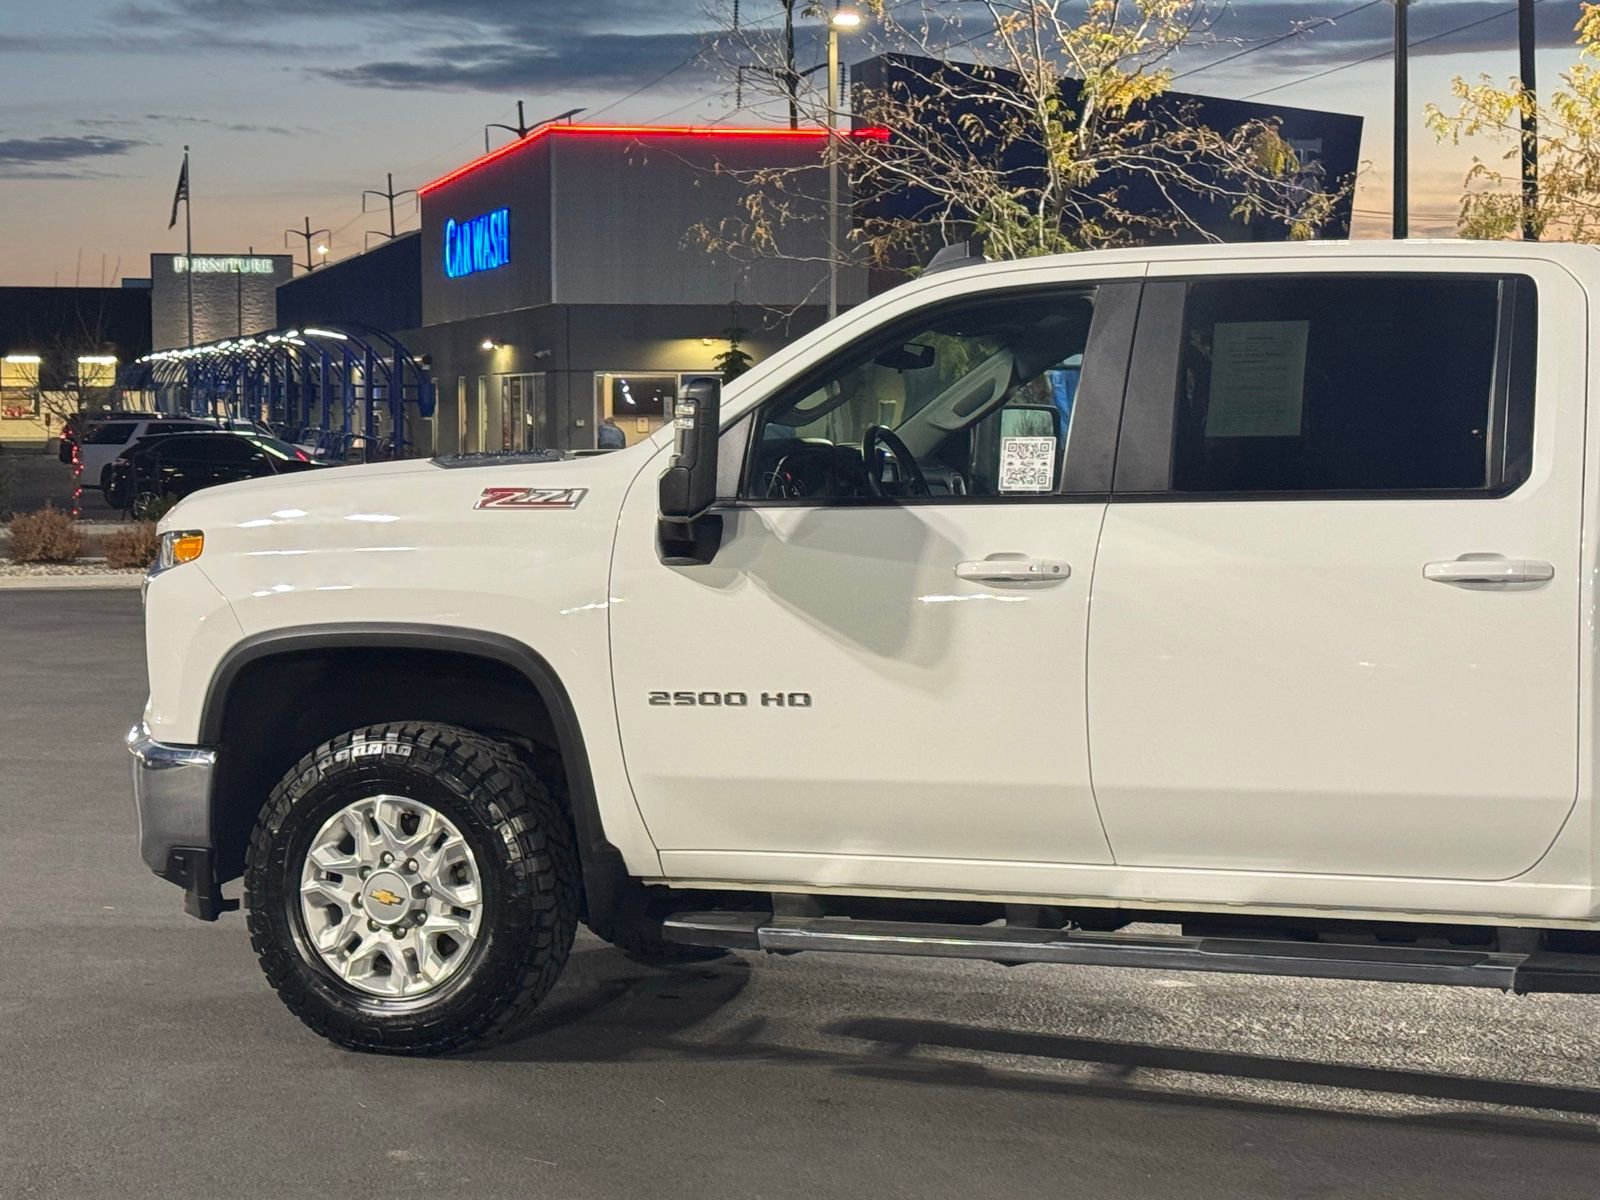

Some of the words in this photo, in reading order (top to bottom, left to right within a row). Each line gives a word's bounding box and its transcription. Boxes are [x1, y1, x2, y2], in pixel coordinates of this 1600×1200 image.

[473, 207, 509, 271] WASH
[173, 256, 274, 273] FURNITURE
[473, 488, 589, 510] Z71
[648, 691, 747, 706] 2500
[760, 692, 812, 707] HD
